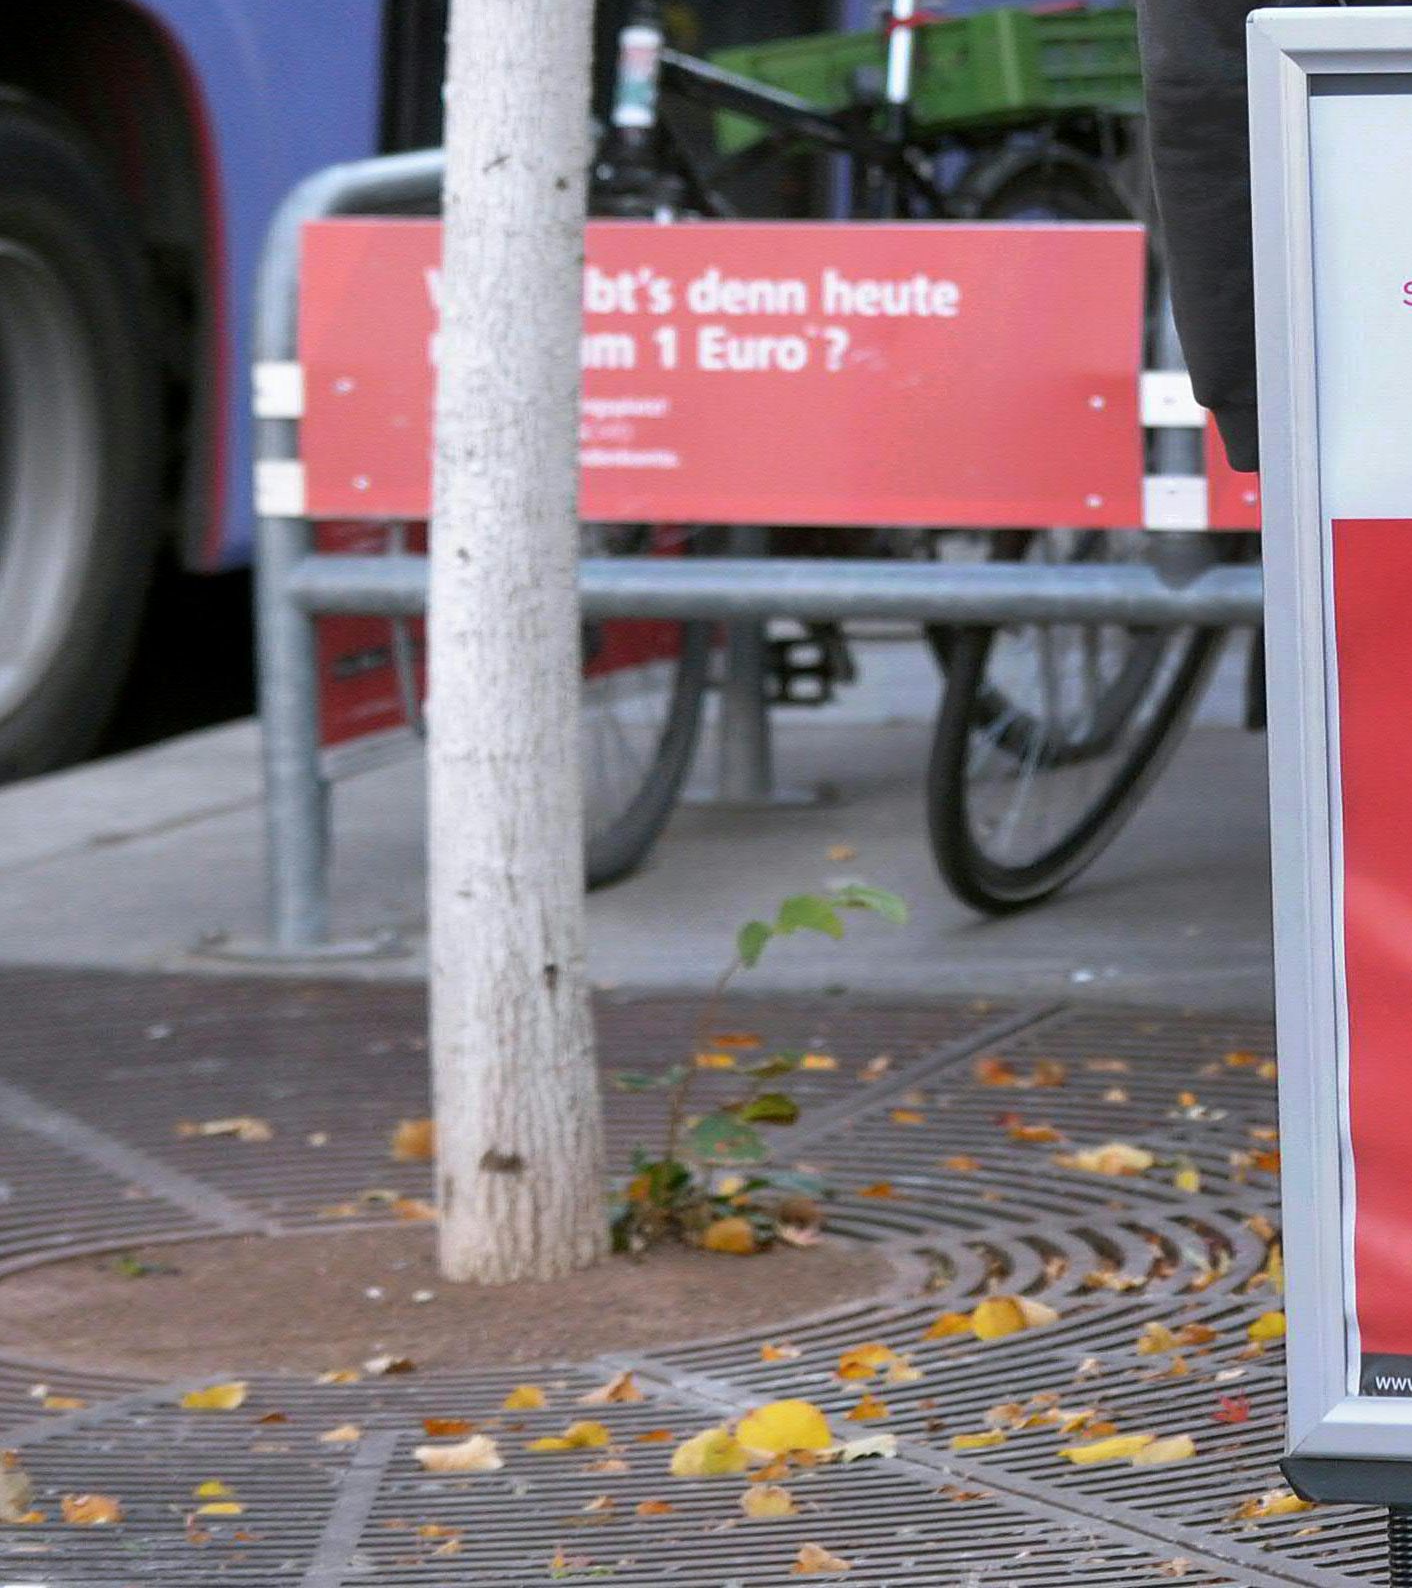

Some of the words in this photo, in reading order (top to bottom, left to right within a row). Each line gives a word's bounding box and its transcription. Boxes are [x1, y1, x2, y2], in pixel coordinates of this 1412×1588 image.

[688, 267, 807, 314] denn
[823, 267, 961, 317] heute
[653, 327, 678, 369] 1
